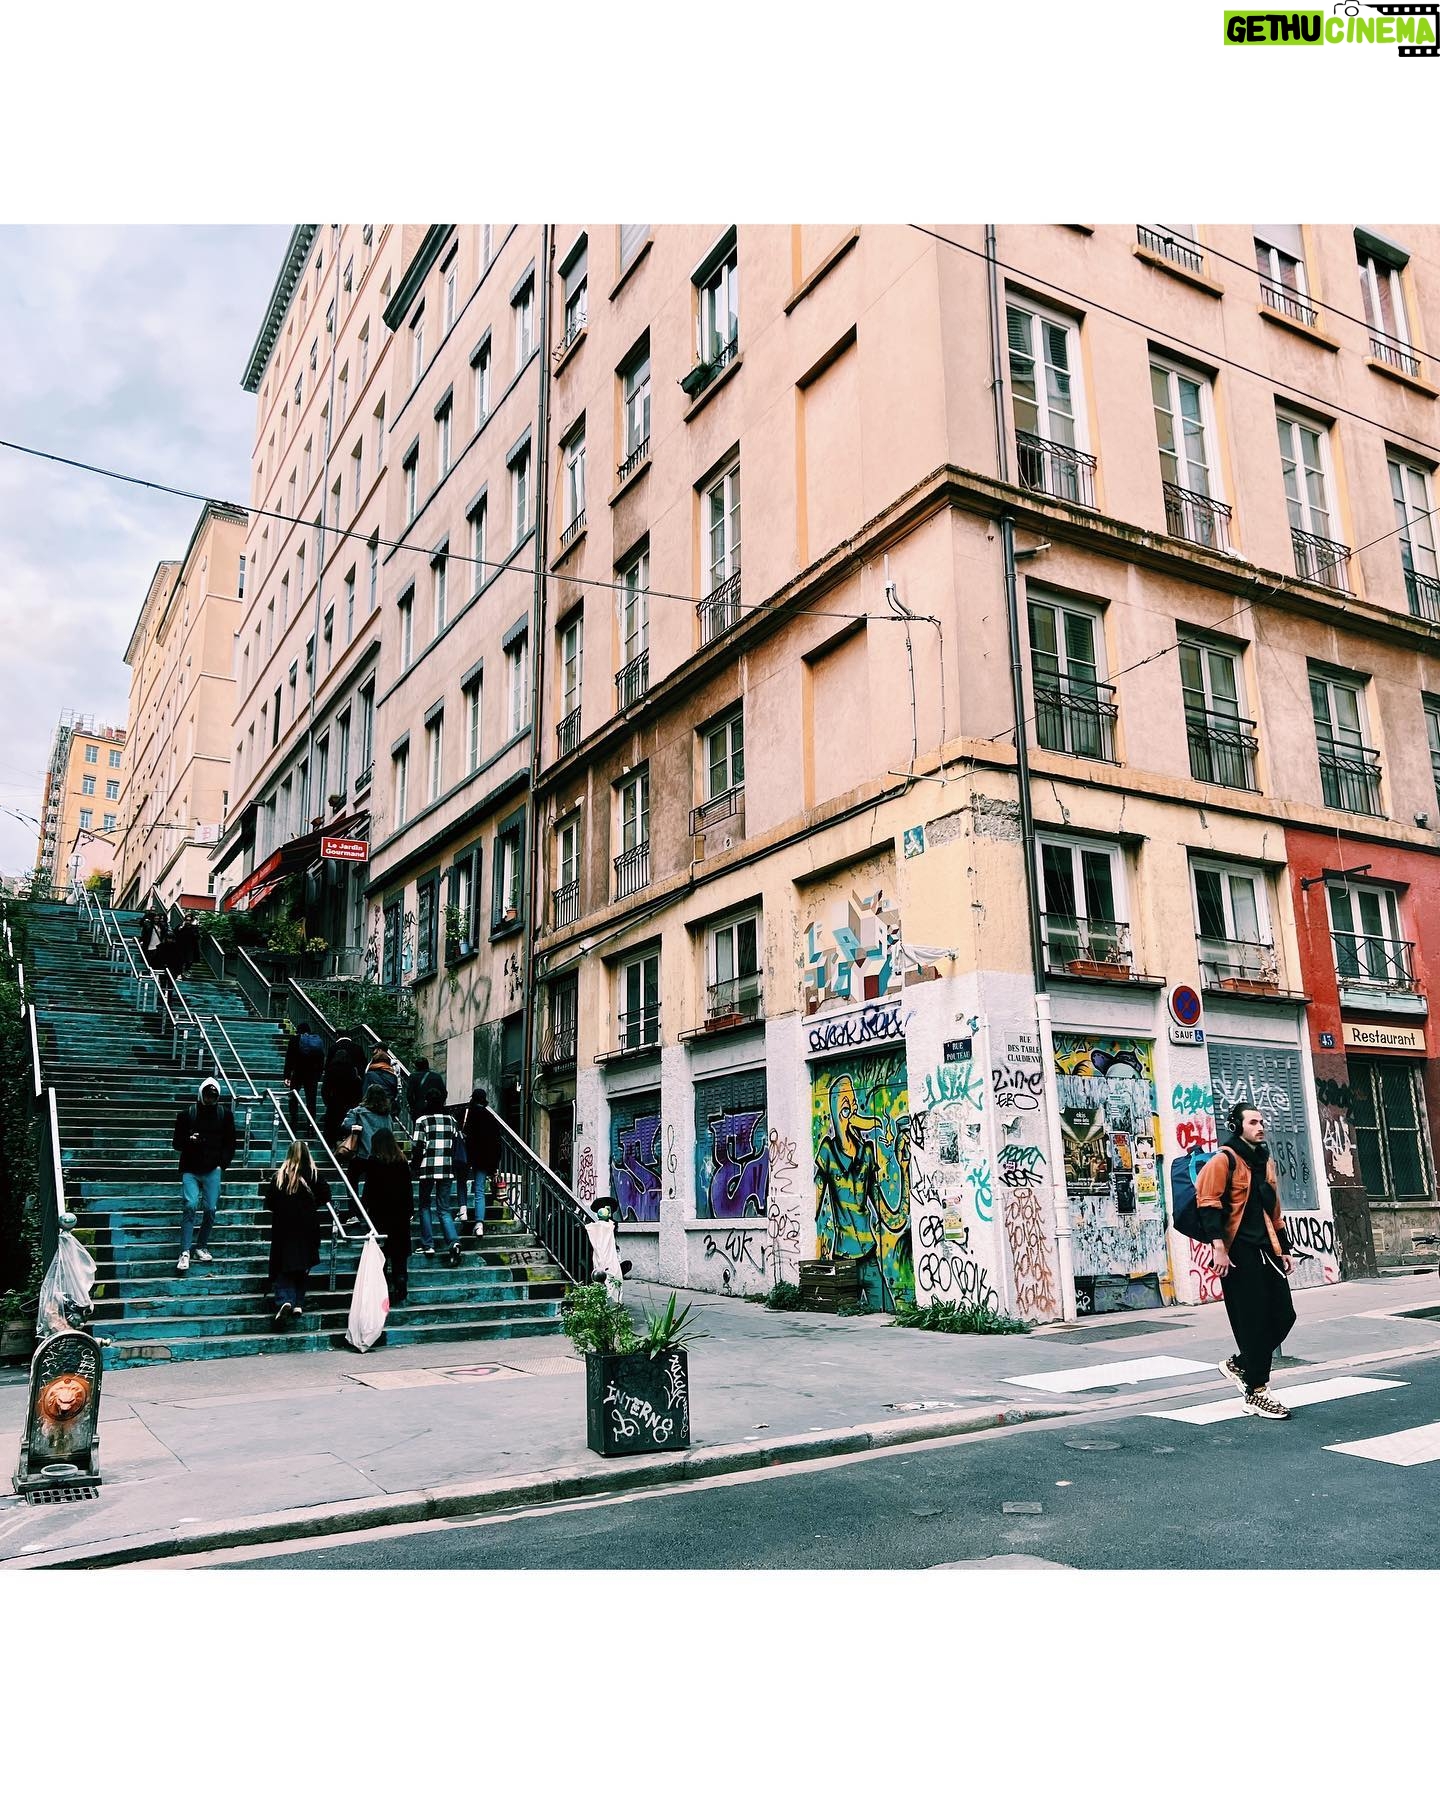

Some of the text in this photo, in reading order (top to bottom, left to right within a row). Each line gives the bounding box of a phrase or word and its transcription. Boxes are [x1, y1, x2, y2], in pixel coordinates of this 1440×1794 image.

[339, 843, 363, 851] Jardin
[325, 848, 365, 857] Gourmand
[1174, 1030, 1193, 1039] SAUF
[1352, 1027, 1416, 1046] Restaurant
[1019, 1035, 1032, 1044] RUE
[952, 1041, 964, 1051] RUE
[1007, 1044, 1040, 1054] DES TABLE
